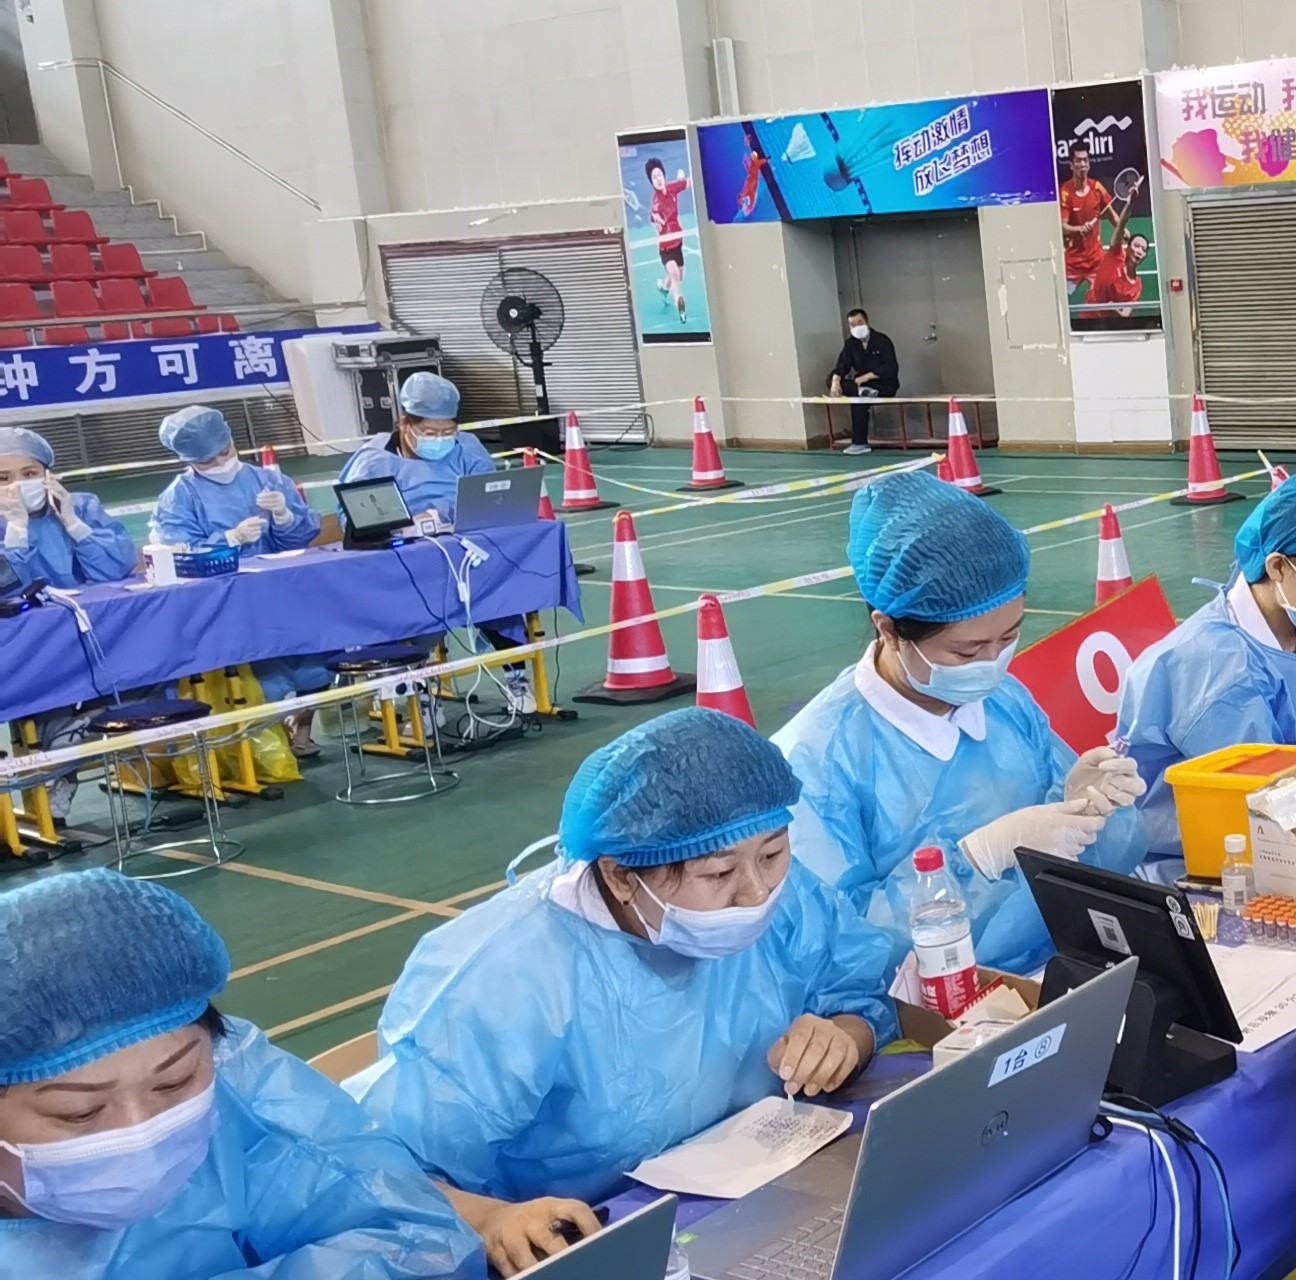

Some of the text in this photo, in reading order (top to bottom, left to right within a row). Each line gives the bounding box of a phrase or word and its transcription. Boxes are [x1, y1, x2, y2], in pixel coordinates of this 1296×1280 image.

[1181, 81, 1266, 121] 我运动
[893, 105, 969, 169] 挥动激情
[914, 131, 992, 195] 放飞梦想
[1004, 1048, 1029, 1075] 1台
